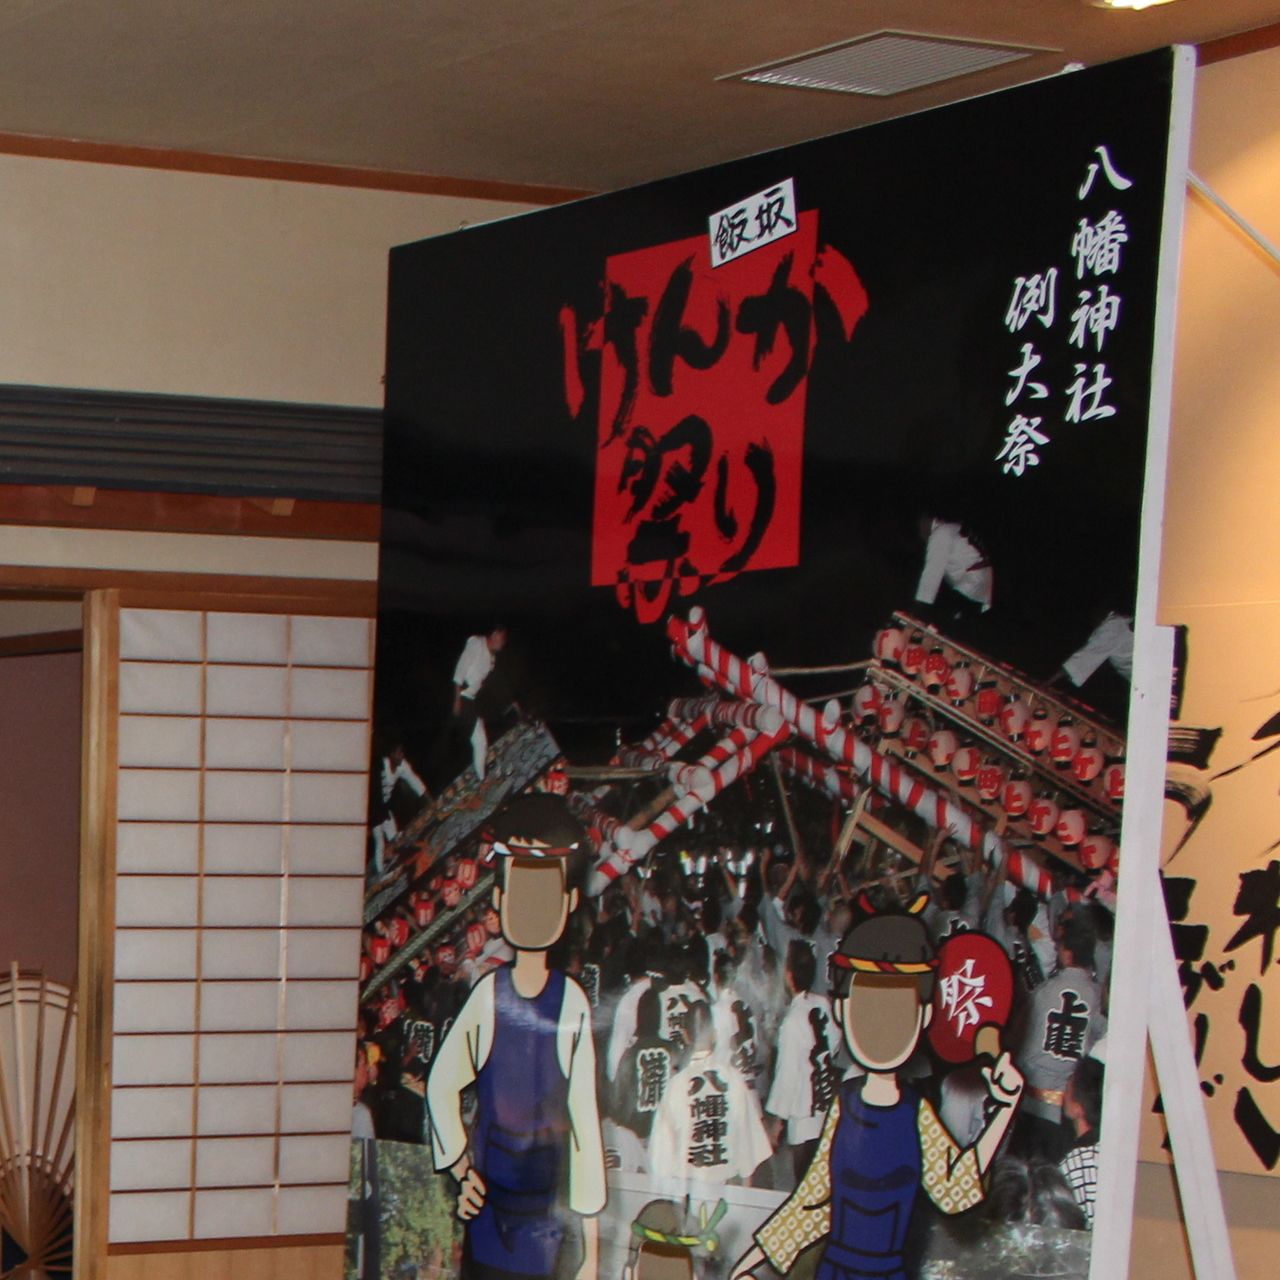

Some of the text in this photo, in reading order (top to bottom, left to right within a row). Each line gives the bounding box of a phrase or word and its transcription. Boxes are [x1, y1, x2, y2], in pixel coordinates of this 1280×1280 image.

[712, 184, 795, 264] 飯坂
[1065, 145, 1134, 425] 八幡神社
[560, 244, 869, 447] けんか
[994, 265, 1055, 478] 例大祭
[941, 958, 993, 1038] 祭
[687, 1069, 730, 1168] 八幡神社
